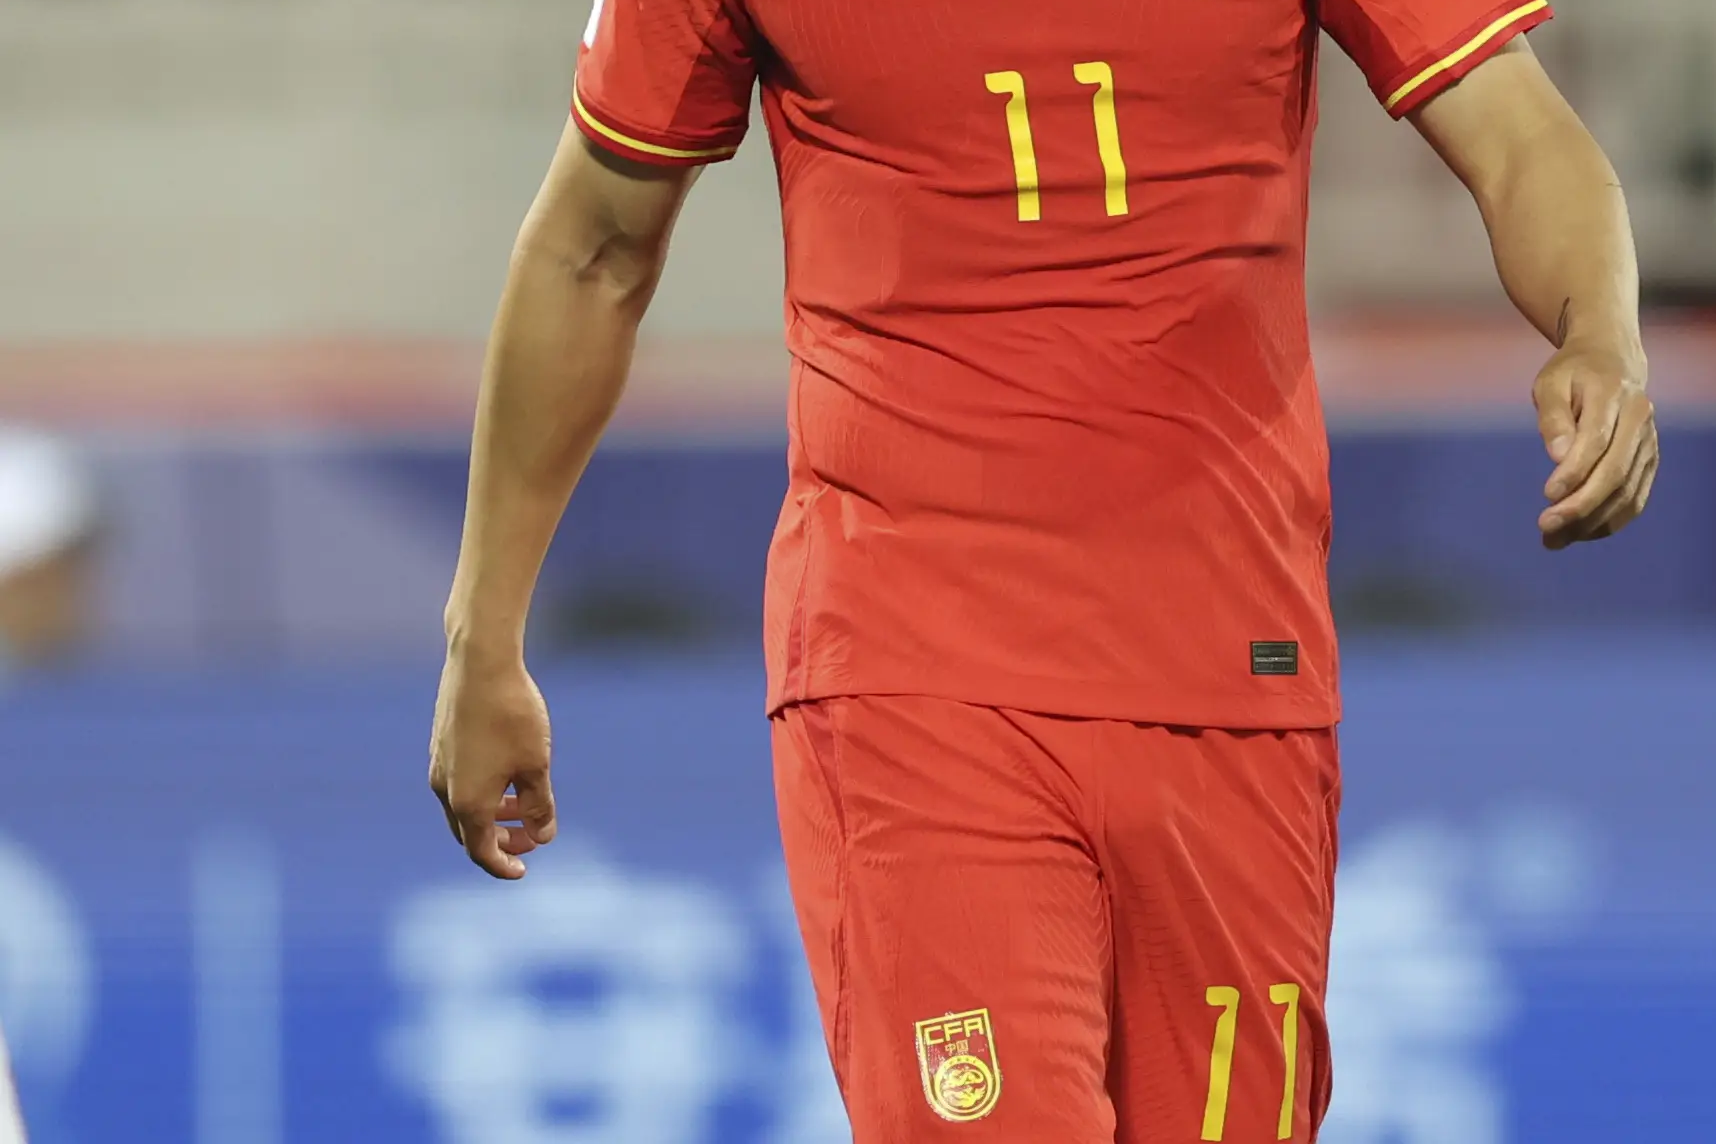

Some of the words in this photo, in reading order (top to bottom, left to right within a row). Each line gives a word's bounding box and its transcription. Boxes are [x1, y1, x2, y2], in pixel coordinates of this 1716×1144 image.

[984, 61, 1129, 222] 11
[924, 1017, 984, 1046] CFA
[1200, 982, 1300, 1142] 11
